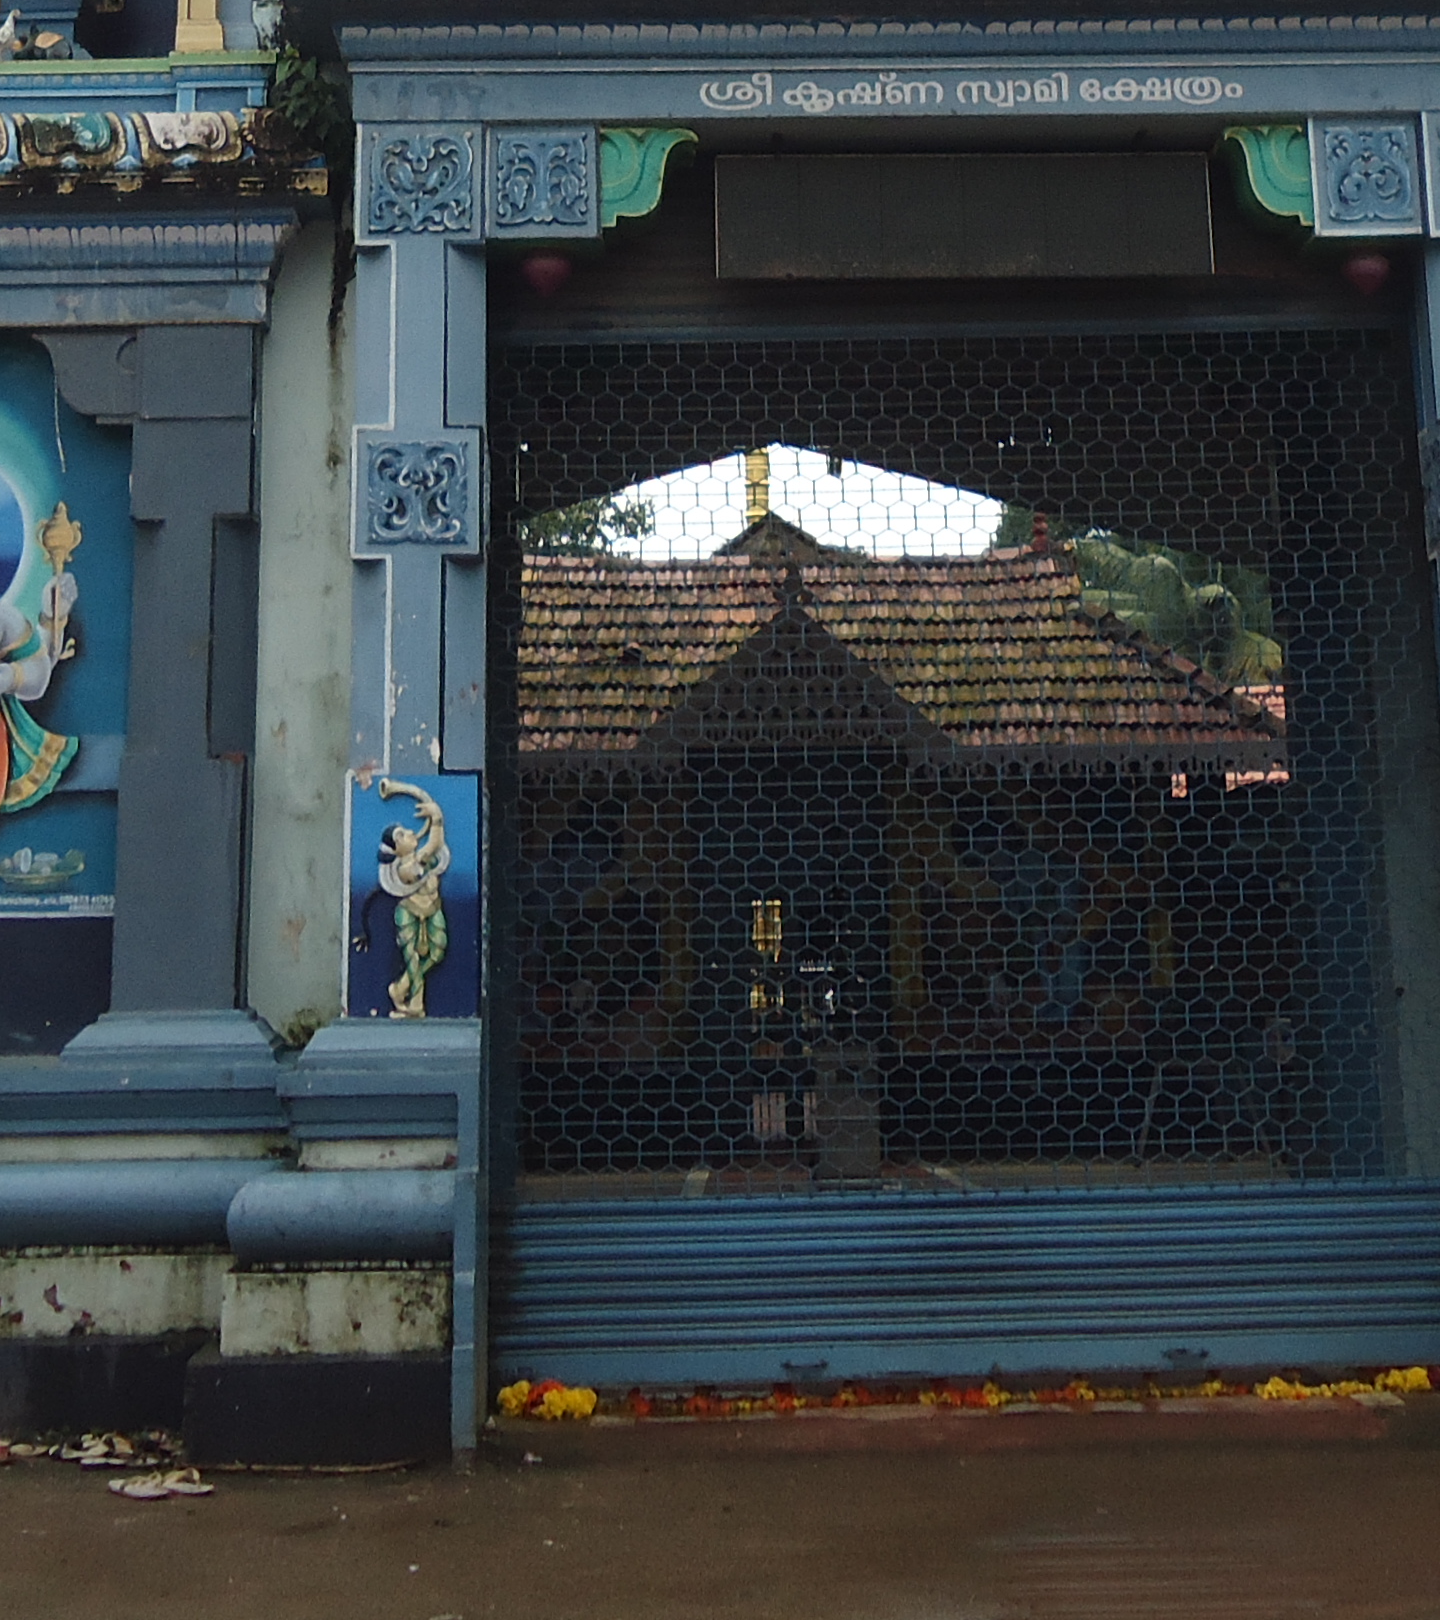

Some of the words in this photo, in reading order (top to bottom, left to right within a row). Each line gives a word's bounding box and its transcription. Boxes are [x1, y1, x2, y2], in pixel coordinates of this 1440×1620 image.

[700, 72, 773, 111] ശ്രീ
[783, 72, 945, 113] കൃഷ്ണ
[956, 72, 1069, 108] സ്വാമി
[1079, 76, 1244, 106] ക്ഷേത്രം
